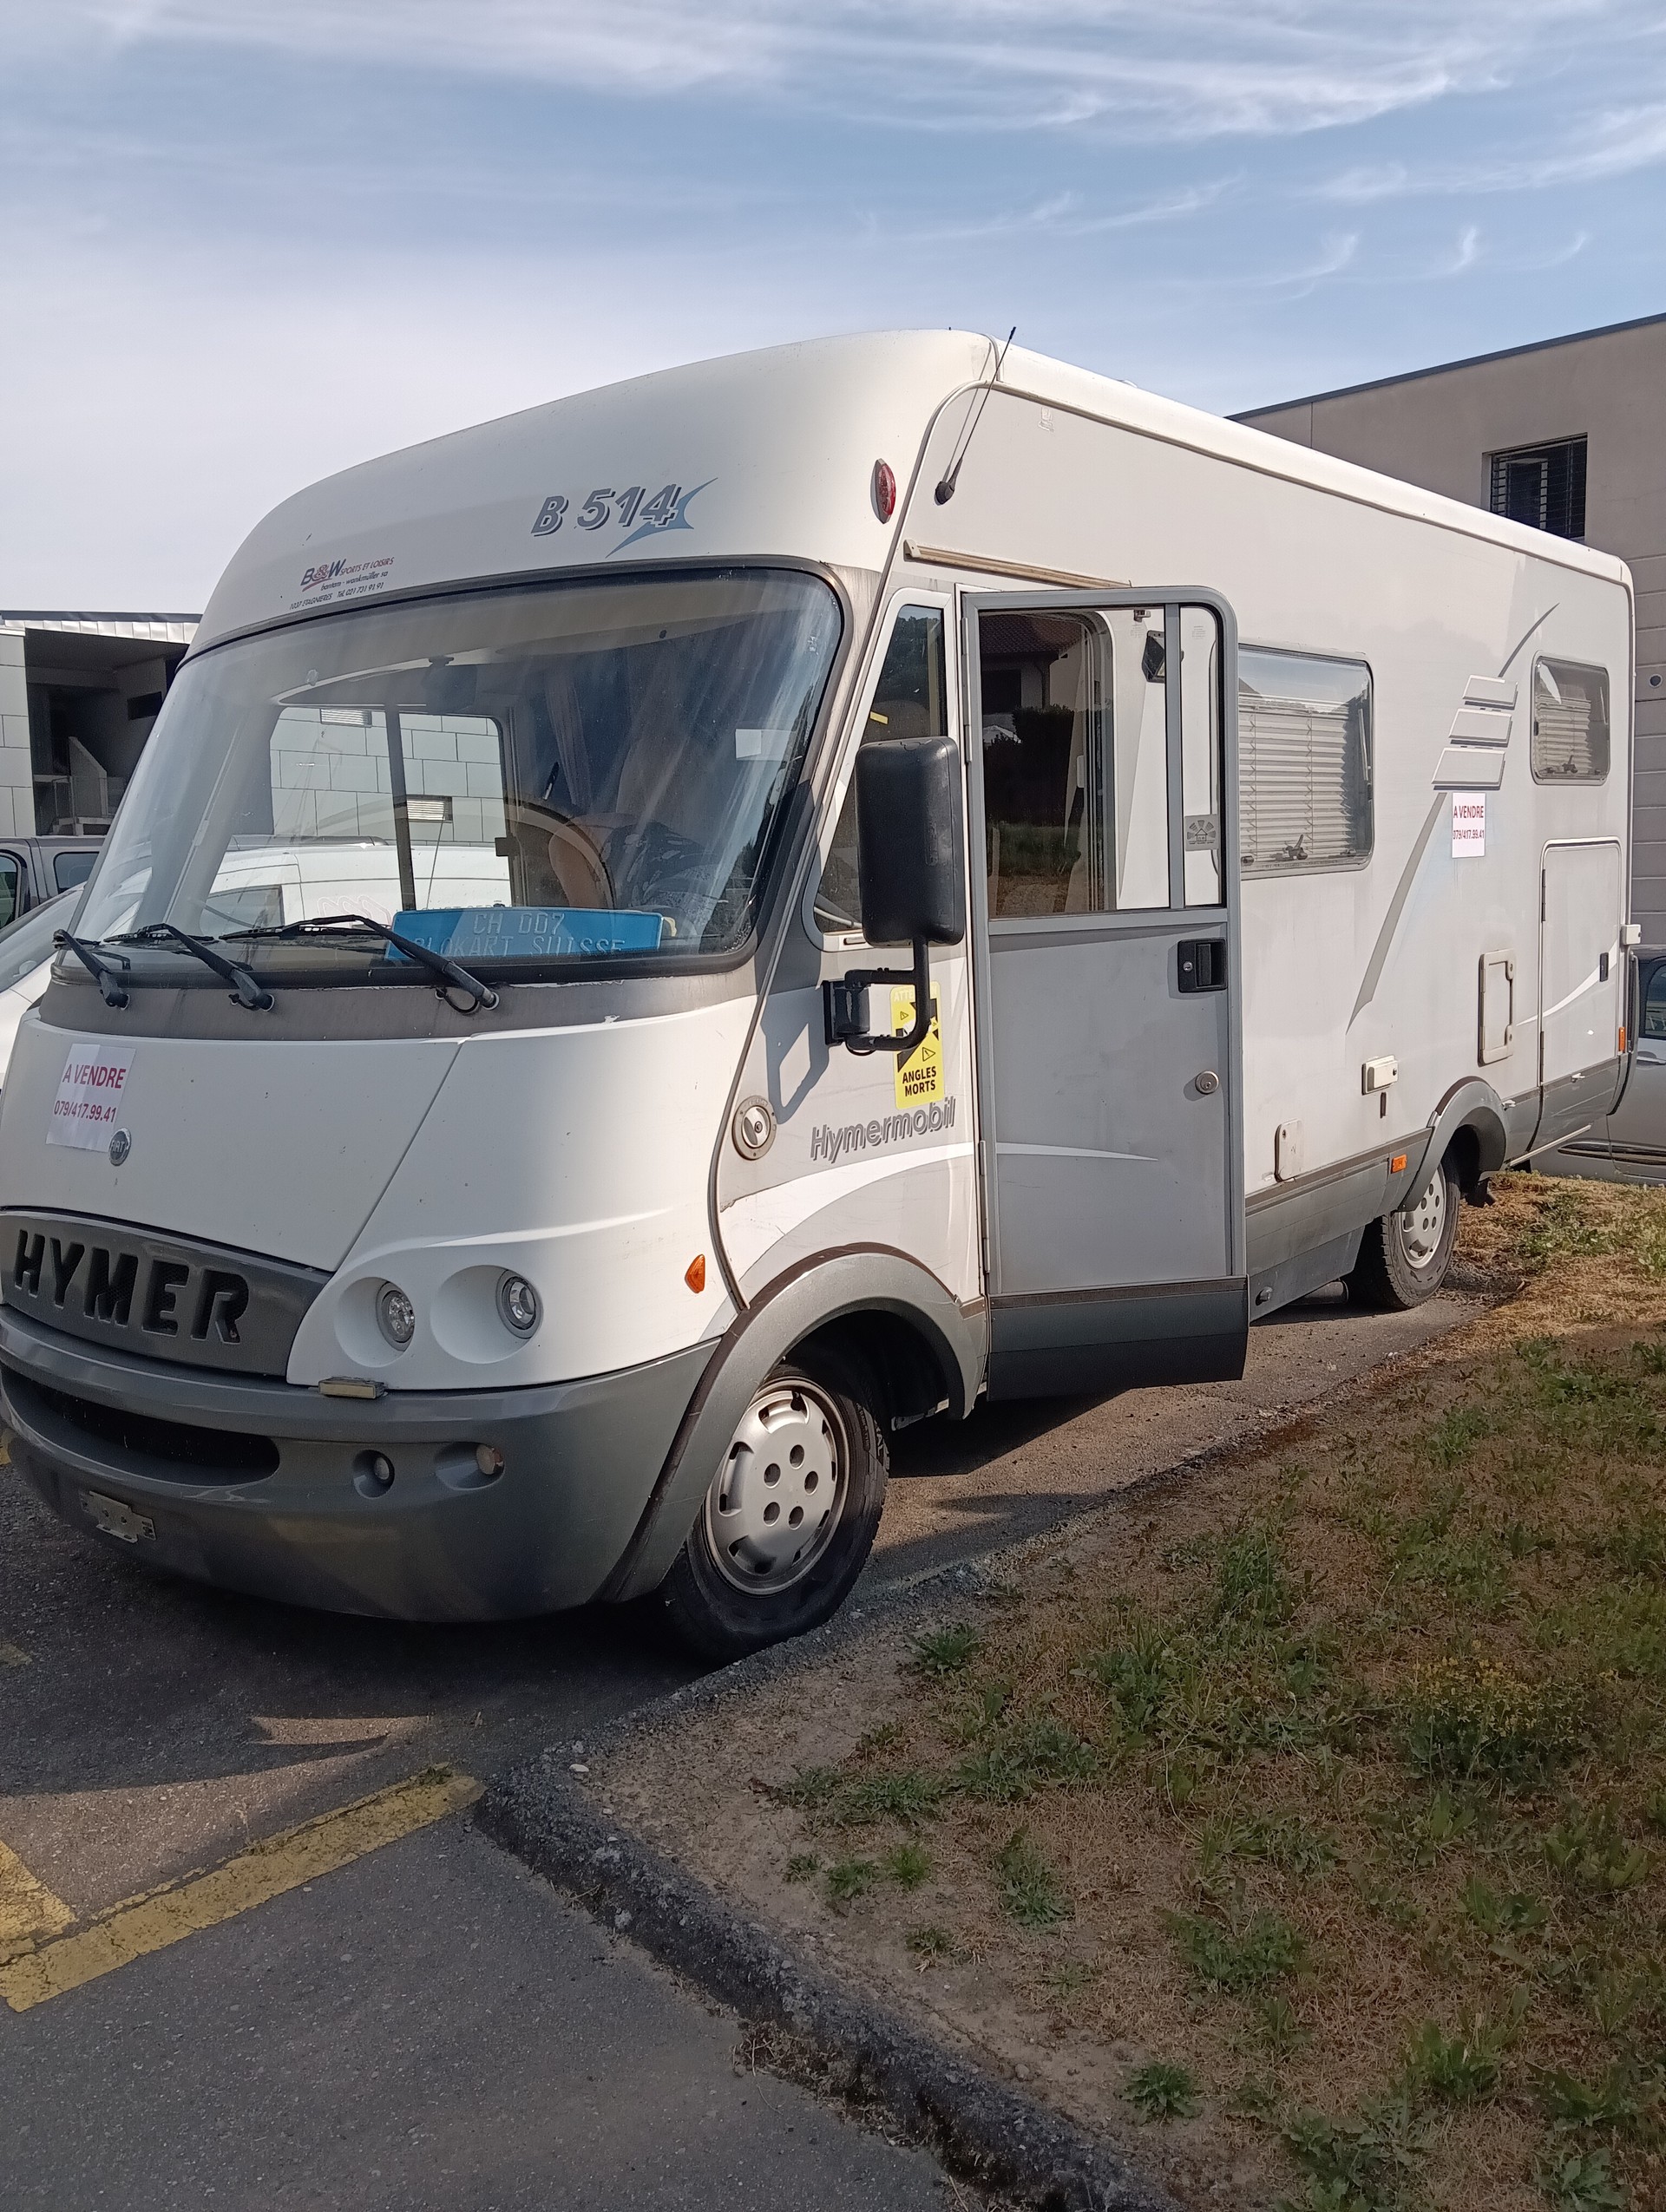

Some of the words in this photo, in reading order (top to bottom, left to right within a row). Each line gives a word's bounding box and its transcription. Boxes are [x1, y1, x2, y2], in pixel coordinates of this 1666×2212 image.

[531, 495, 569, 537] B
[577, 483, 682, 531] 514
[300, 559, 346, 586] B&W
[1459, 805, 1484, 818] VENDRE
[473, 913, 504, 935] CH
[62, 1063, 73, 1083] A
[74, 1064, 127, 1090] VENDRE
[902, 1066, 937, 1084] ANGLES
[904, 1080, 936, 1097] MORTS
[54, 1100, 117, 1123] 079/417.99.41
[810, 1096, 956, 1163] Hymermobil
[13, 1229, 249, 1344] HYMER
